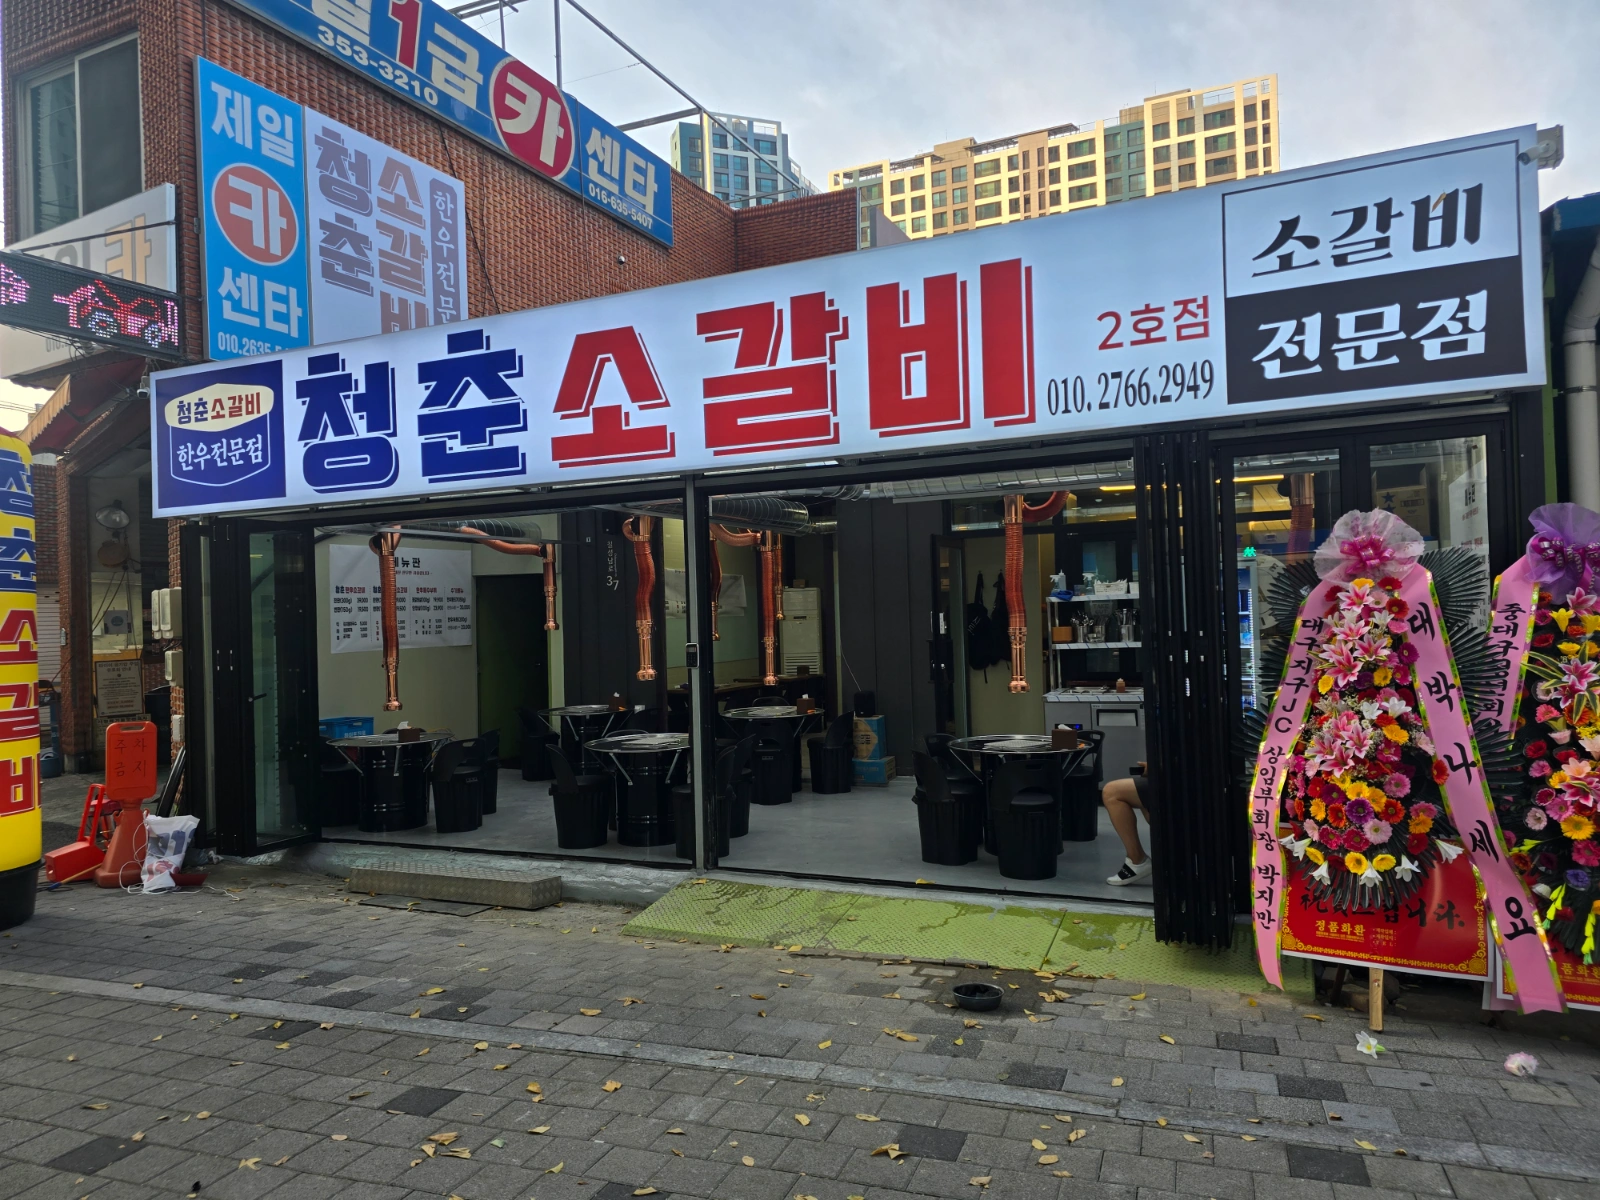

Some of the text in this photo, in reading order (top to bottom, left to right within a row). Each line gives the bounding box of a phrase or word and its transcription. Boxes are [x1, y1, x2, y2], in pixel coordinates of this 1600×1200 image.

[317, 25, 438, 106] 353-3210
[210, 81, 295, 167] 제일
[499, 72, 564, 168] 카
[586, 127, 658, 216] 센타
[228, 174, 287, 257] 카
[314, 126, 374, 298] 청춘
[589, 182, 653, 230] 016-635-5407
[1251, 183, 1483, 278] 소갈비
[218, 266, 302, 338] 센타
[1096, 295, 1210, 351] 2호점
[1252, 289, 1488, 380] 전문점
[177, 392, 261, 425] 청춘소갈비
[296, 258, 1036, 493] 청춘소갈비
[1046, 358, 1214, 417] 010.2766.2949
[177, 434, 263, 471] 한우전문점
[114, 738, 148, 755] 주차
[114, 759, 147, 778] 금지
[1253, 746, 1286, 851] 상임부회장
[1255, 863, 1280, 930] 박지만
[1315, 920, 1366, 937] 정품화환
